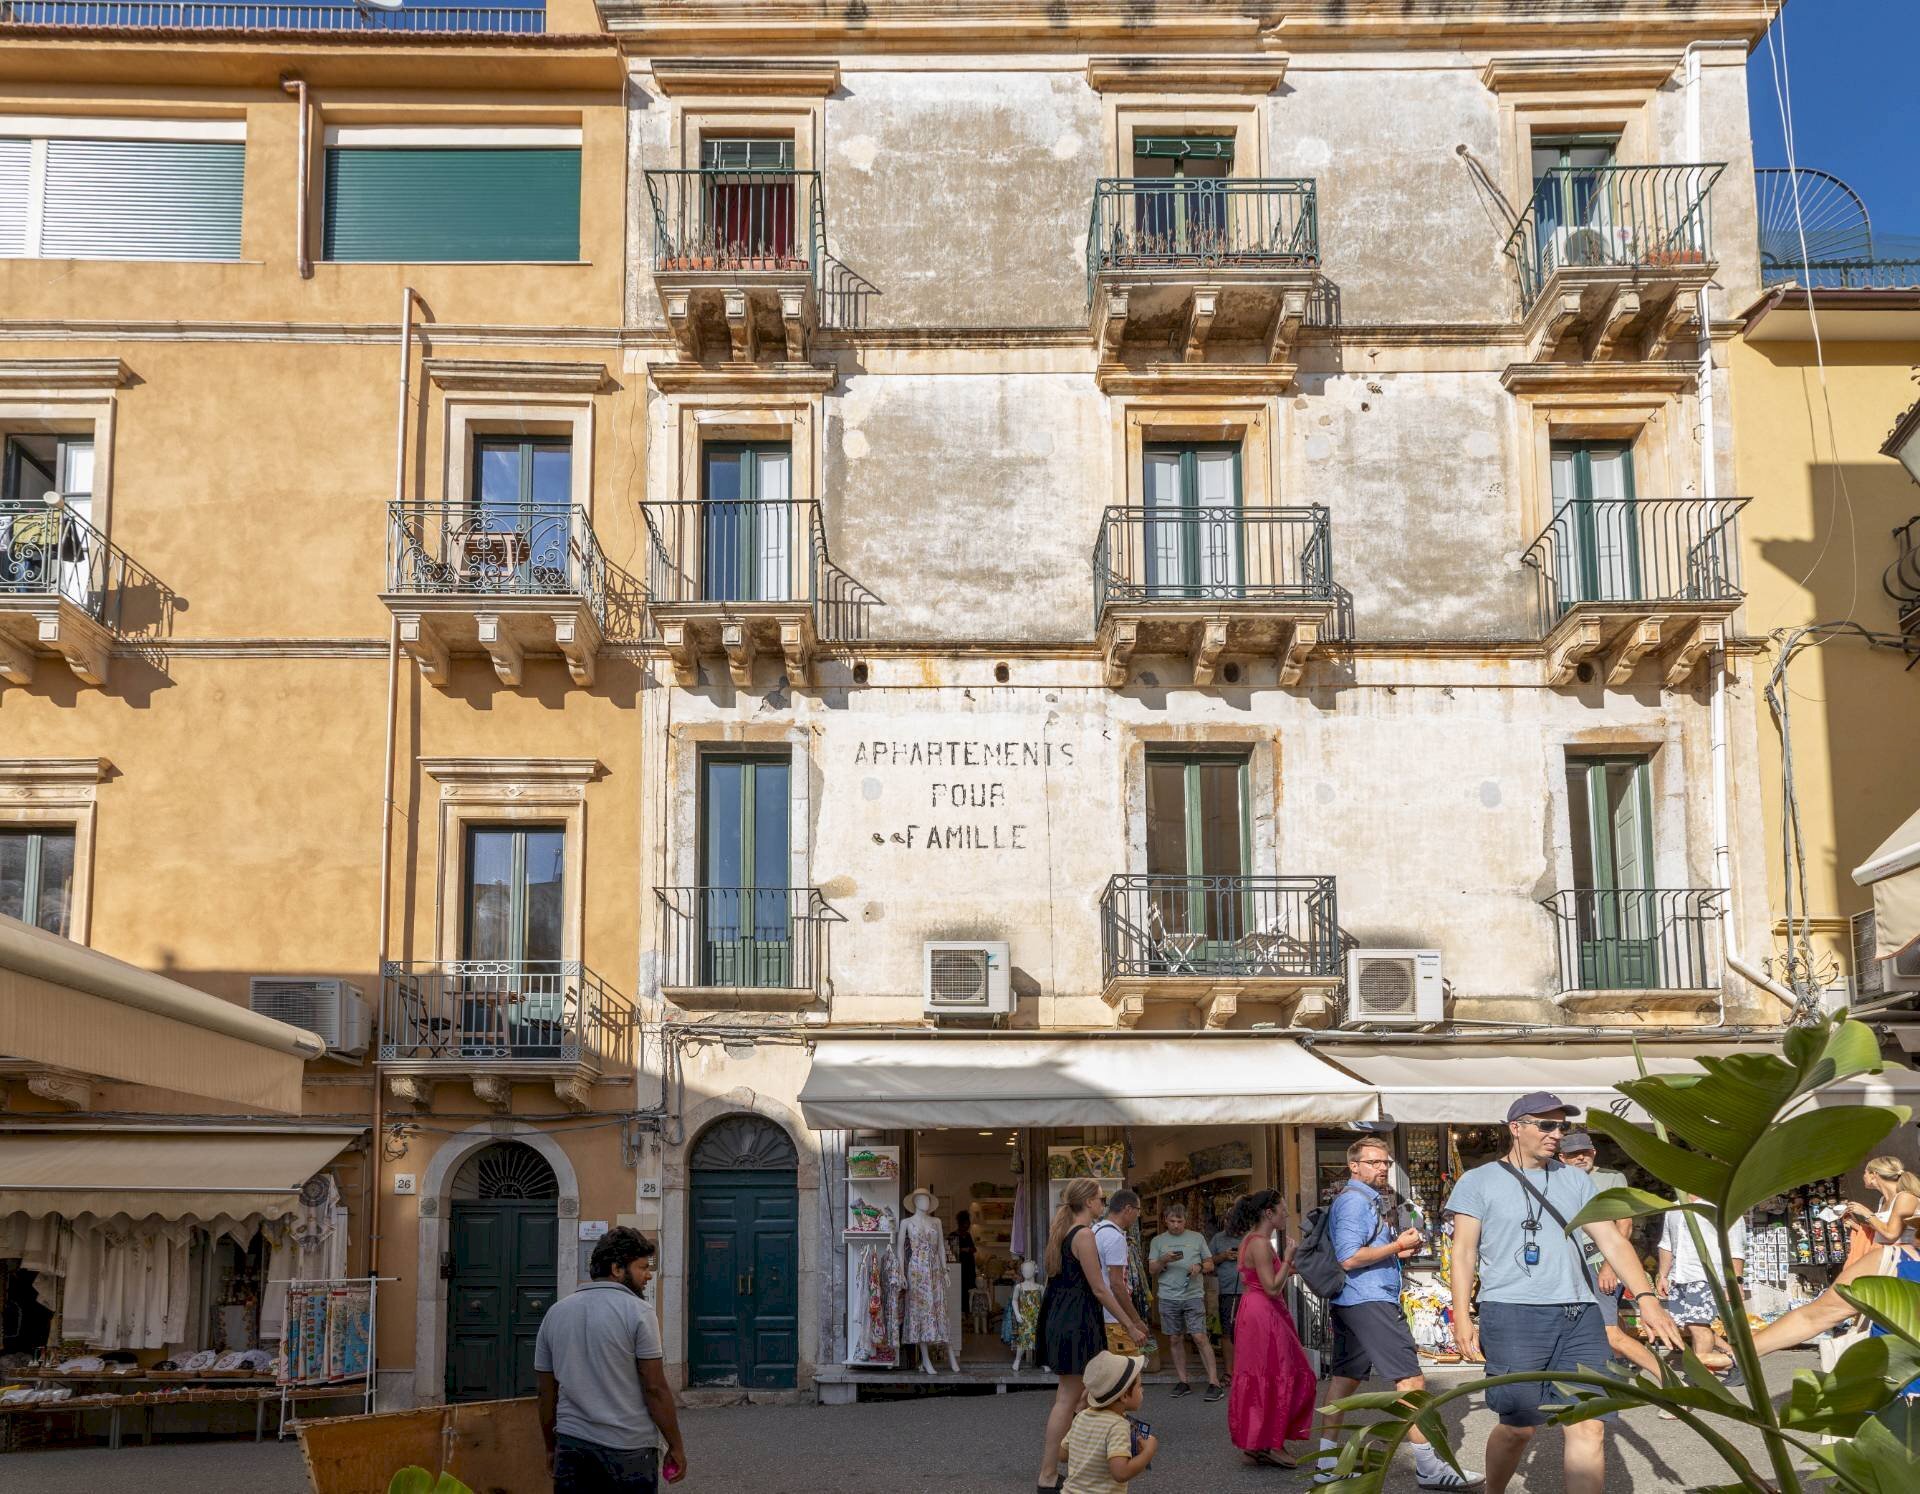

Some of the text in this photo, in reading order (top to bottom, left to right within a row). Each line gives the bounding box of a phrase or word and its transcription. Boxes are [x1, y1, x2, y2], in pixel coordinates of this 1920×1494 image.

[932, 783, 1005, 807] POUR
[906, 825, 1027, 848] FAMILLE
[397, 1179, 411, 1190] 26
[643, 1183, 656, 1193] 28
